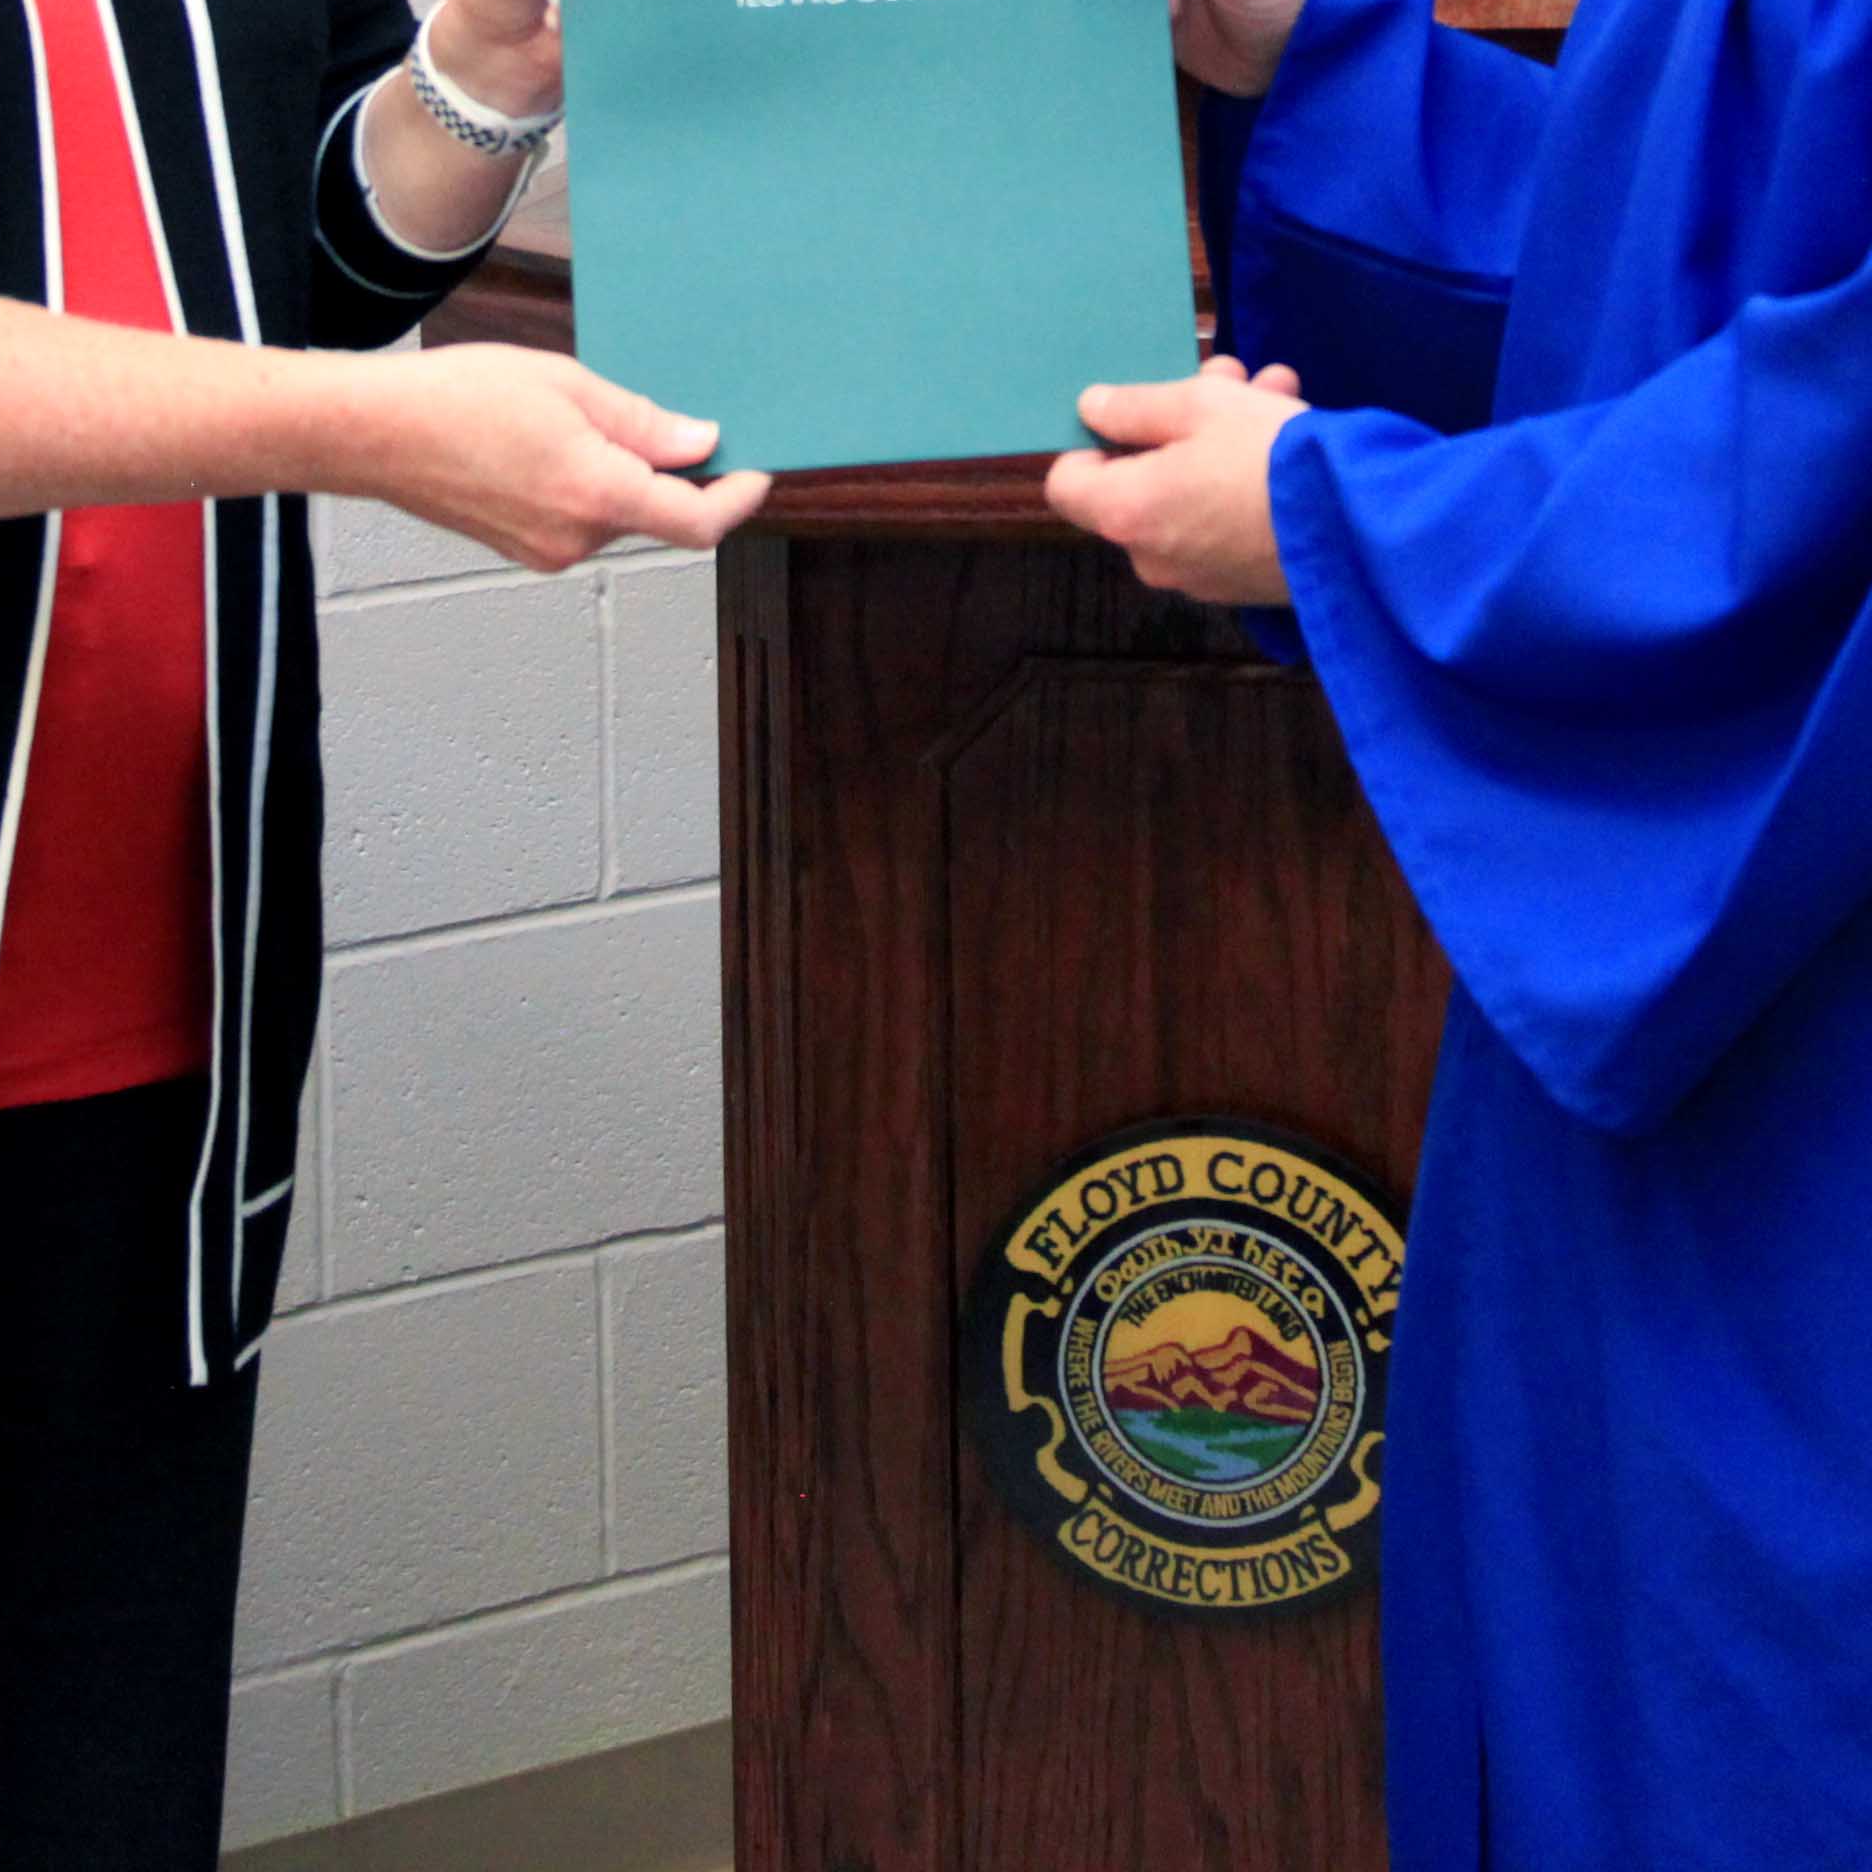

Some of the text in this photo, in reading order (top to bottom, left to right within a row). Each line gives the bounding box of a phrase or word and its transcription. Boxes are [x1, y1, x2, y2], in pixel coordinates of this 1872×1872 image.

[1025, 1152, 1185, 1268] FLOYD
[1207, 1152, 1402, 1304] COUNTY
[1067, 1315, 1356, 1518] WHERE THE RIVERS MEET AND THE MOUNTAINS BEGIN
[1069, 1509, 1341, 1601] CORRECTIONS
